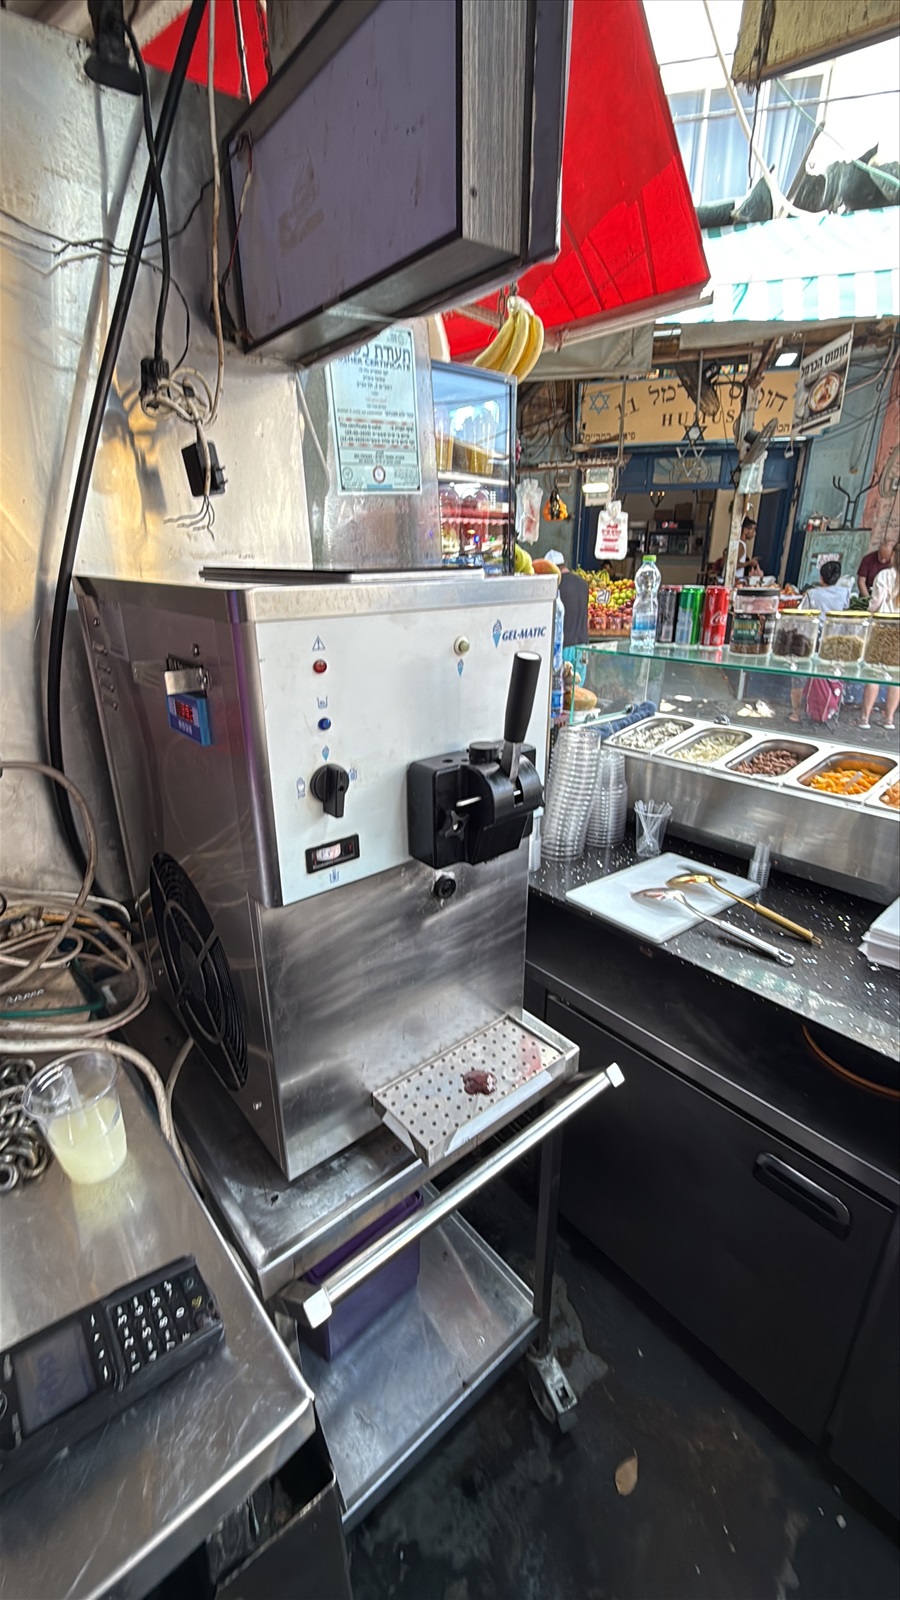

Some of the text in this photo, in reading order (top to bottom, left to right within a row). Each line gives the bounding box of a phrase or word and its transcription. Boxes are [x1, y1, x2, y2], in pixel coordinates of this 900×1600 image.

[375, 344, 411, 365] תעודת
[800, 342, 849, 379] חומוס הכרמל
[364, 358, 411, 372] CERTIFICATE
[117, 1314, 128, 1327] 3
[142, 1326, 152, 1339] 5
